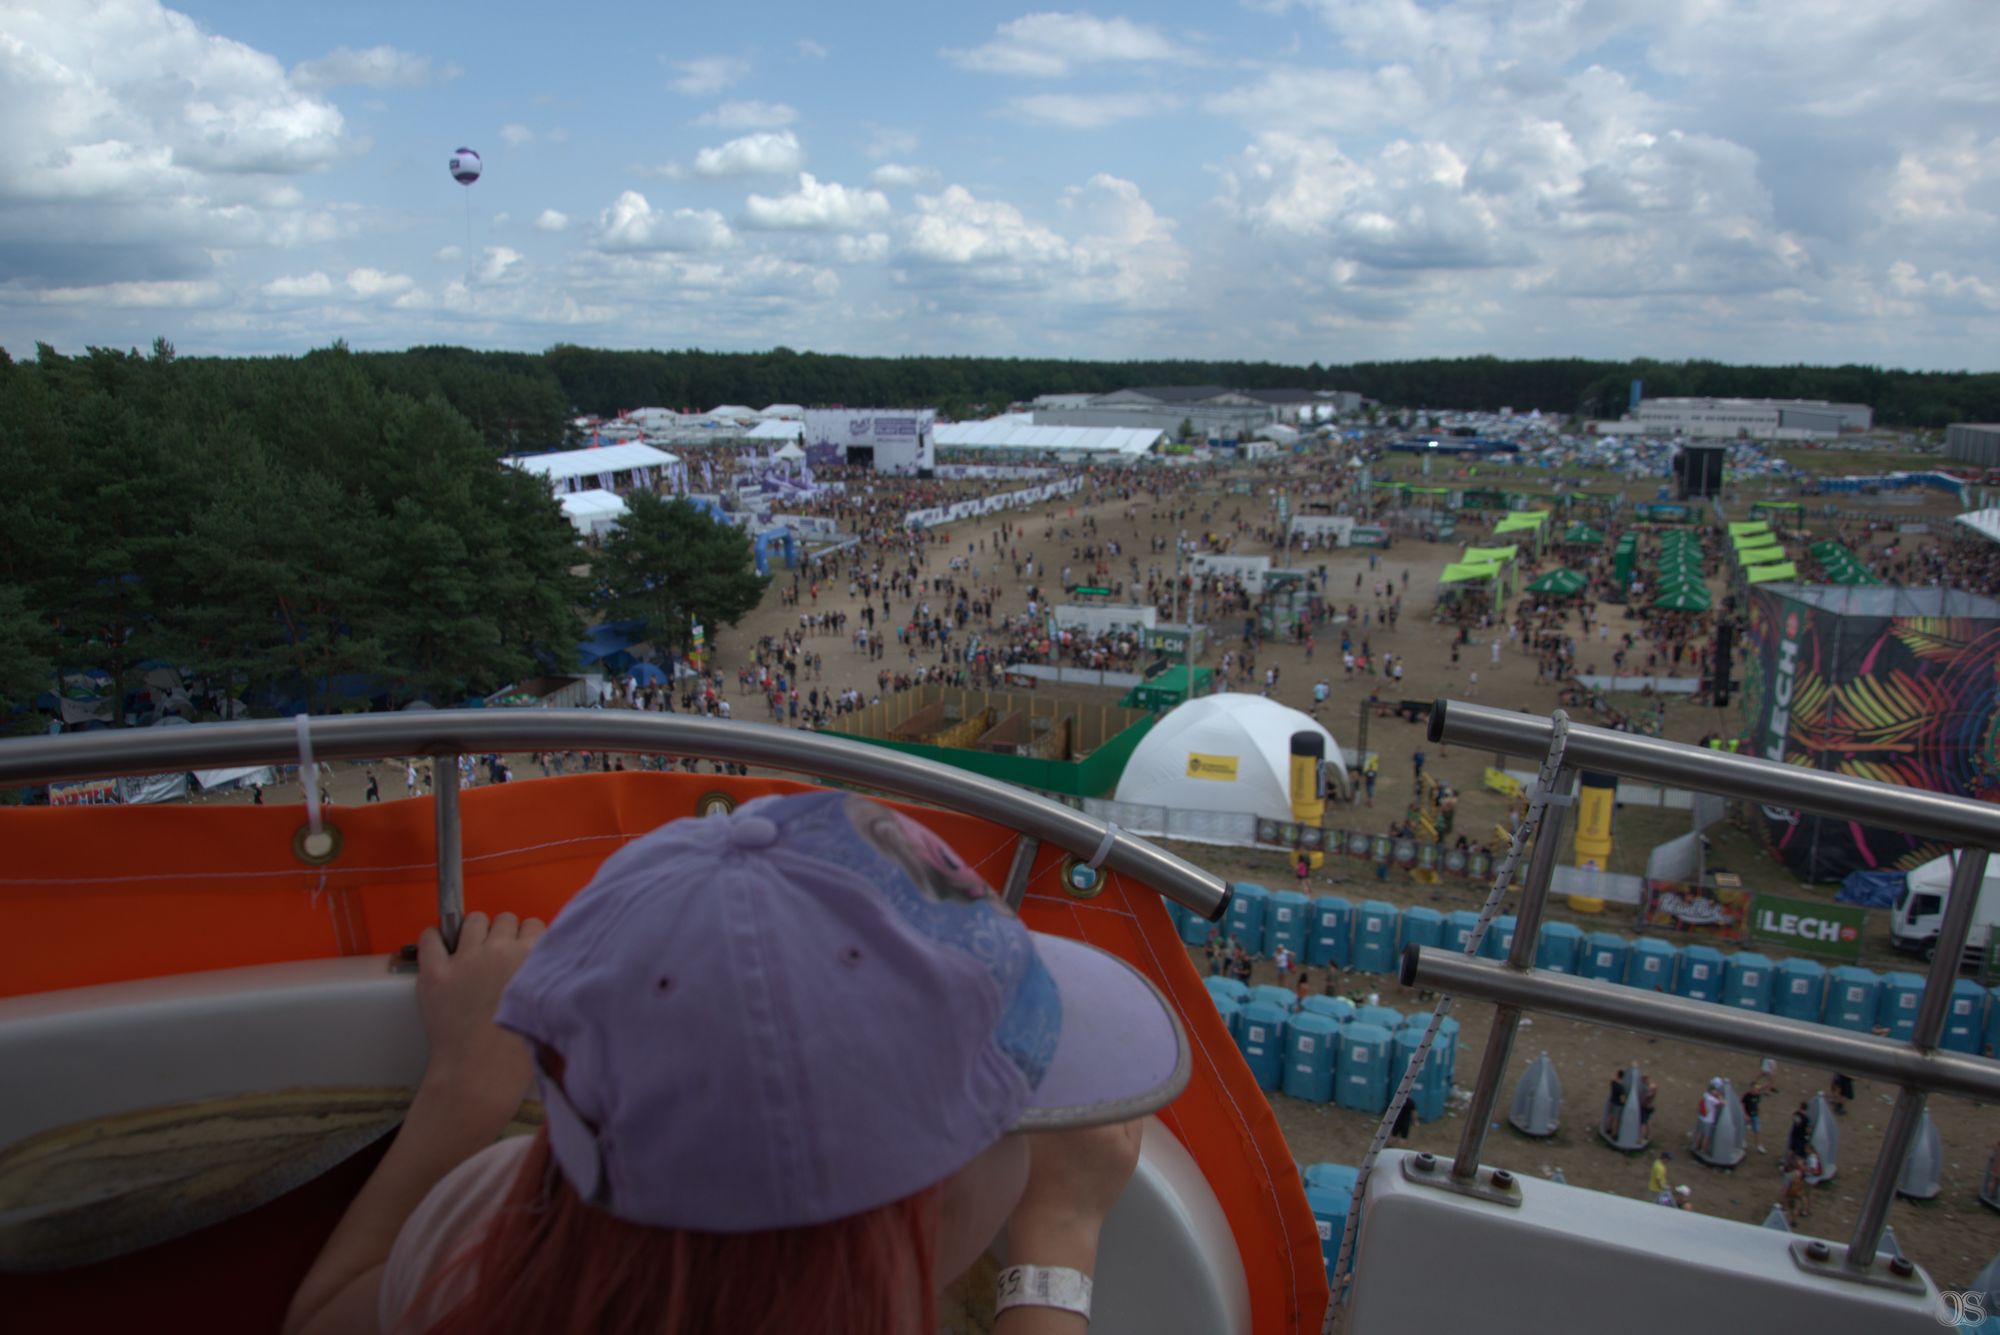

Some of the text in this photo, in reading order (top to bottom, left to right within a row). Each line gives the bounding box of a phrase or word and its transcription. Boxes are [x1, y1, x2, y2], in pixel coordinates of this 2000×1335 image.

[1149, 637, 1184, 652] LCH
[1766, 639, 1799, 763] LECH
[1762, 910, 1841, 942] LECH
